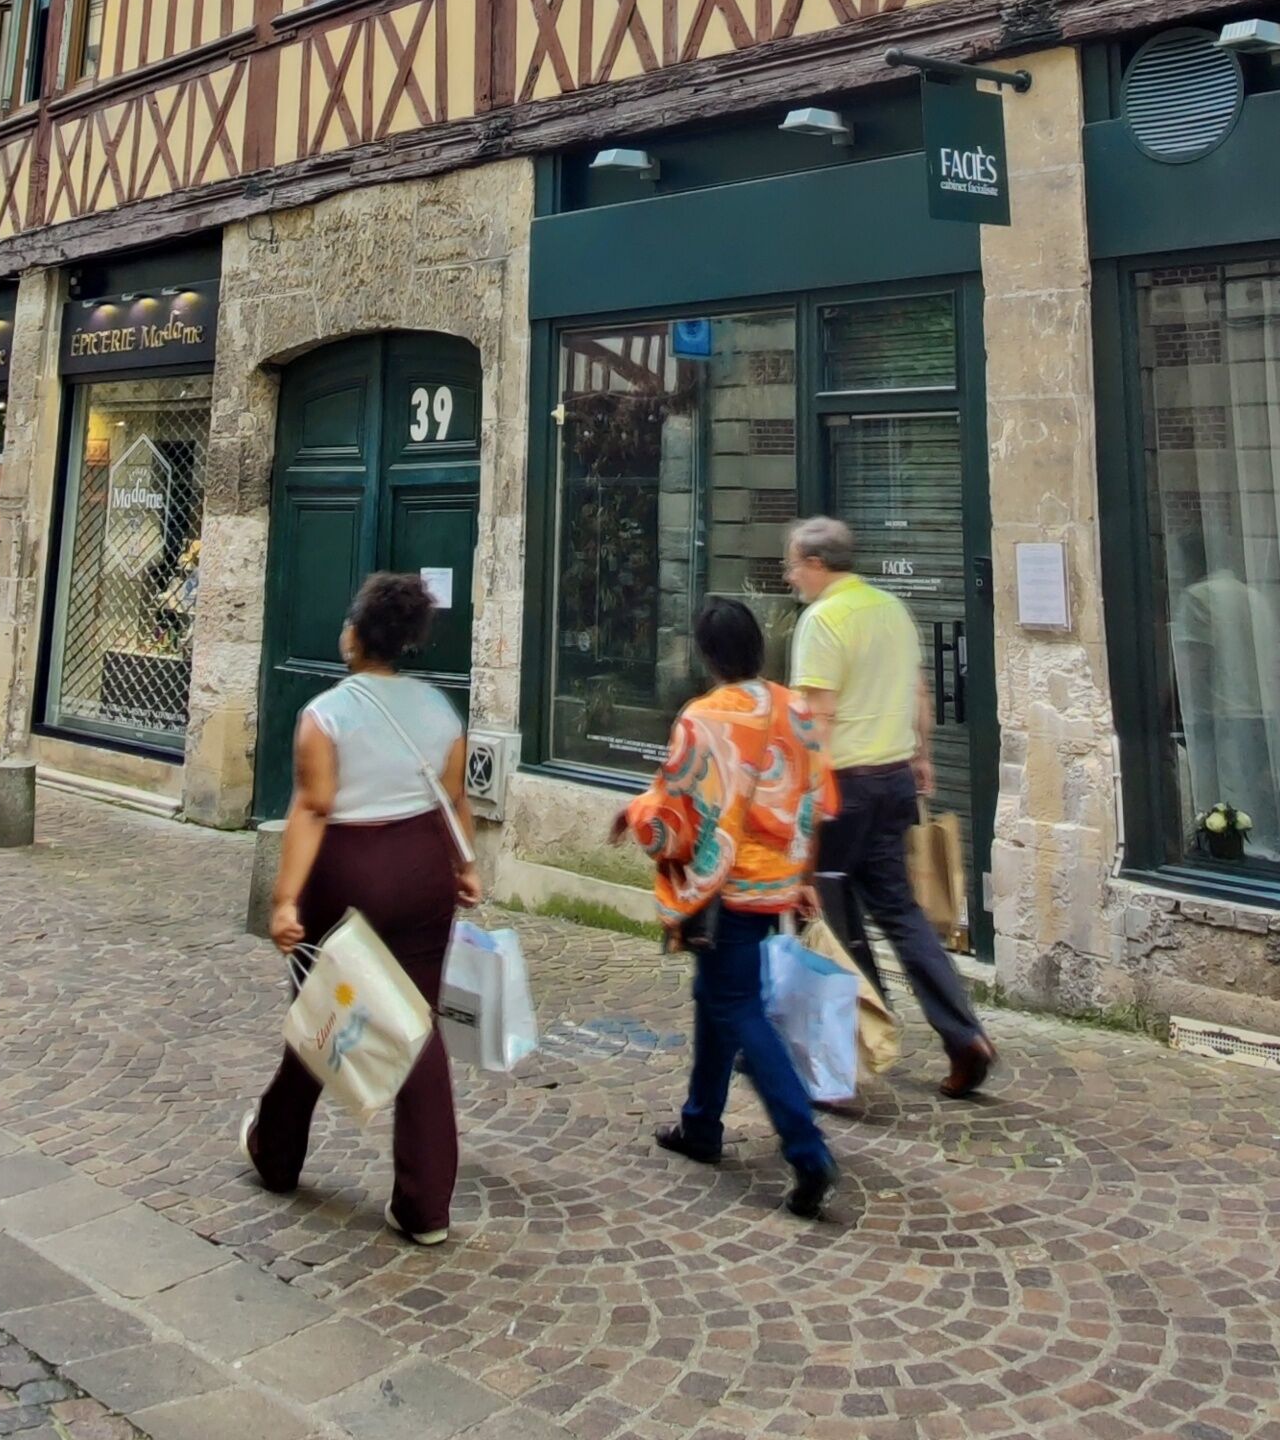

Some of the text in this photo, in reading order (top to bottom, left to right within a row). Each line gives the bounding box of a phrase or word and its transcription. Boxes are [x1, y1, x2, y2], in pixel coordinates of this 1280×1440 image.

[940, 146, 998, 184] FACIÈS
[70, 309, 204, 356] ÉPICERIE Madame
[410, 386, 453, 442] 39
[113, 478, 163, 509] Madame
[882, 558, 914, 576] FACIÈS
